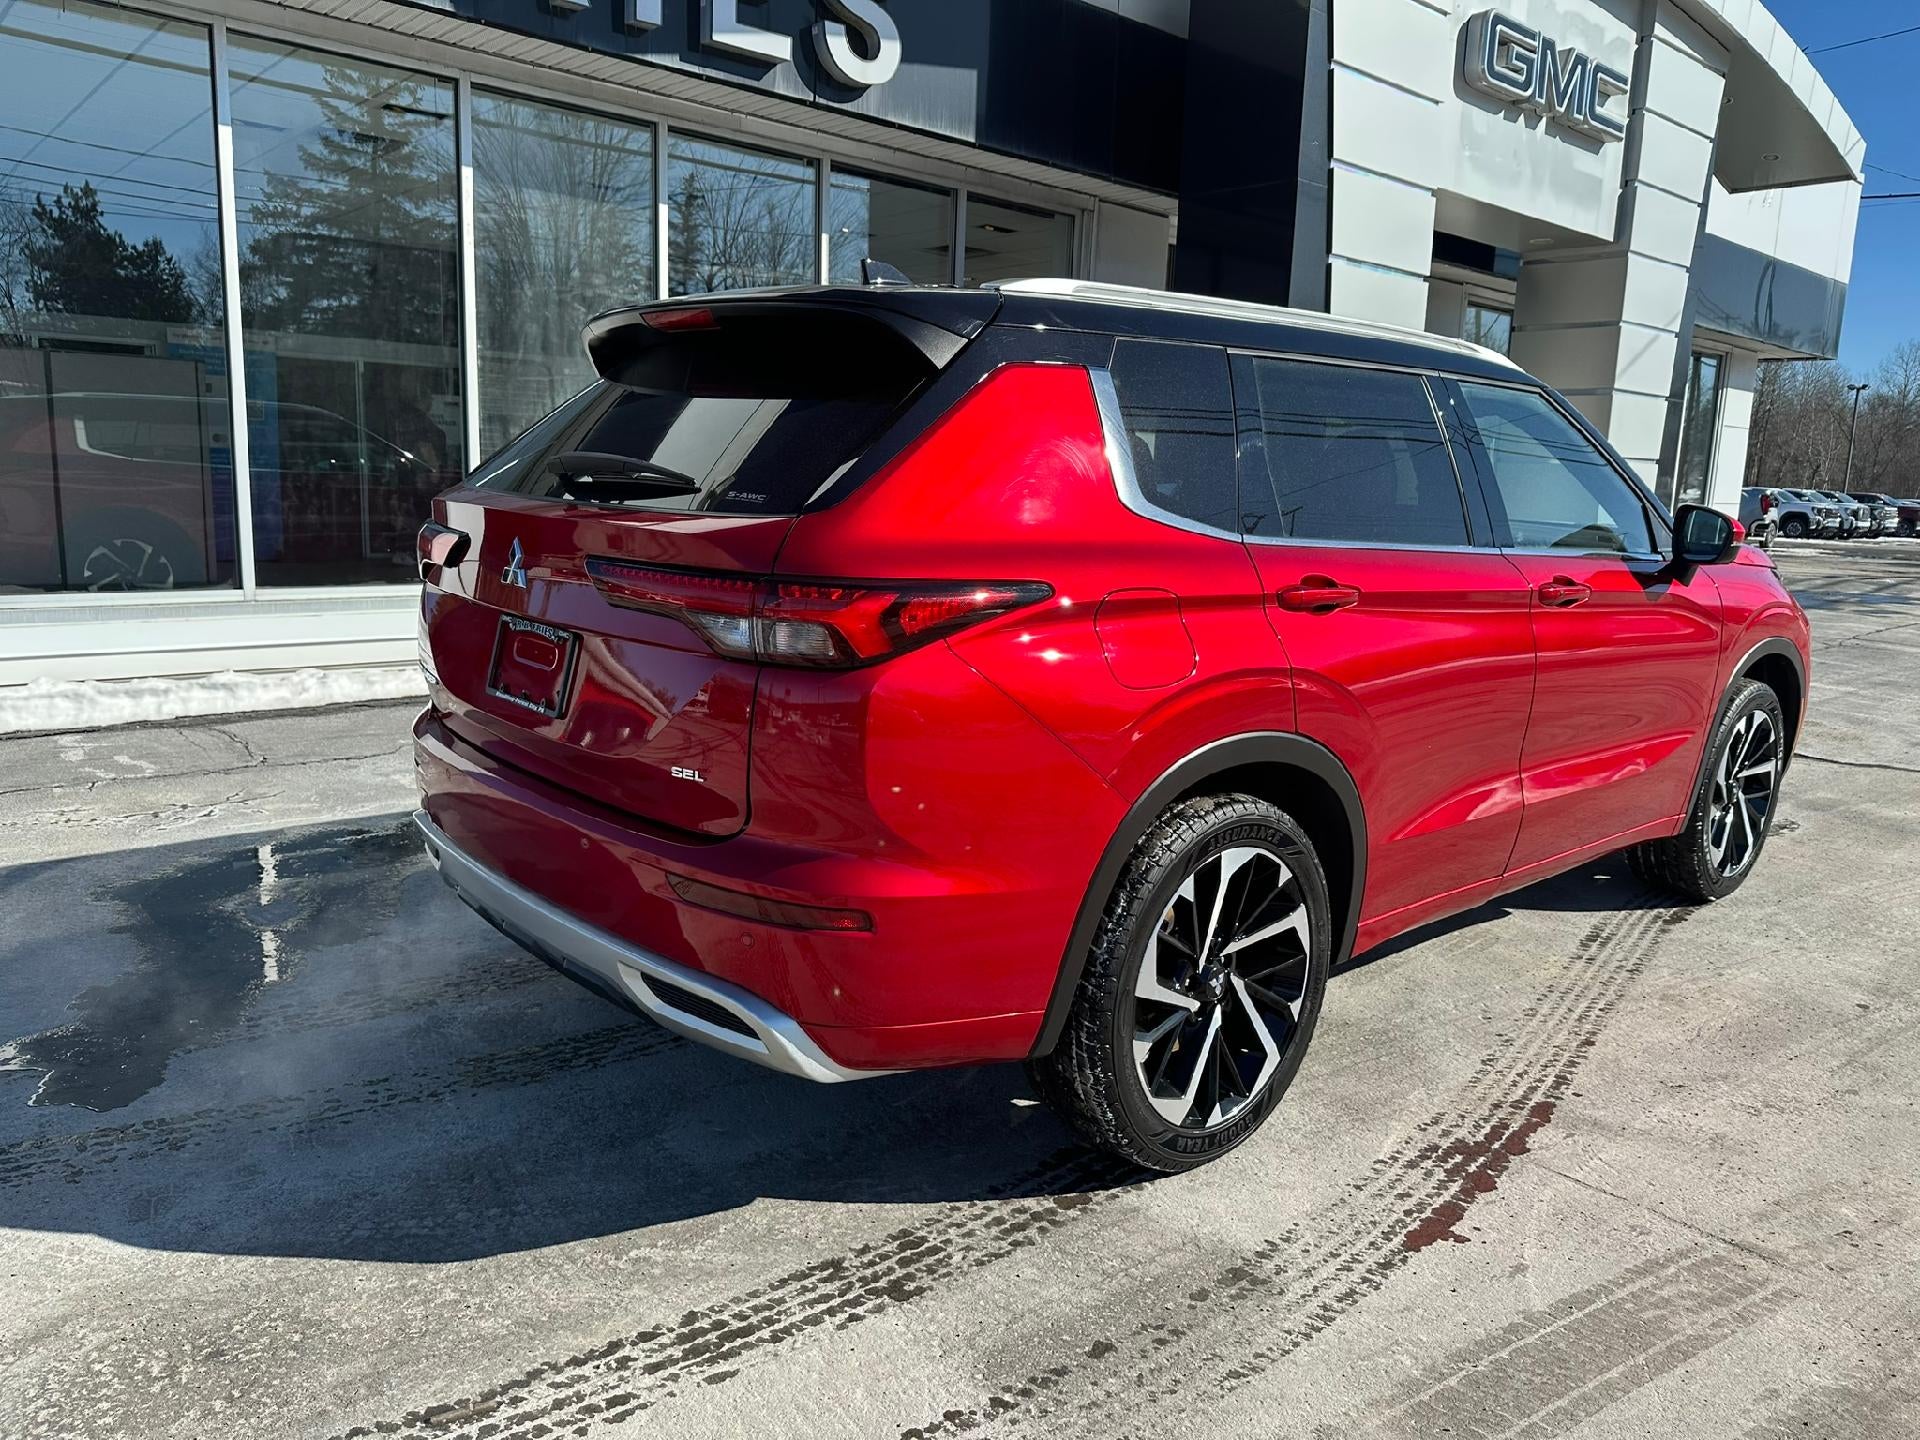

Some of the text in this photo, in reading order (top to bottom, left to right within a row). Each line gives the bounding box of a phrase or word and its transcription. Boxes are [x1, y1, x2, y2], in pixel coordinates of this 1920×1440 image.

[1484, 9, 1629, 137] GMC
[727, 490, 767, 501] S-AWC
[670, 766, 704, 782] SEL
